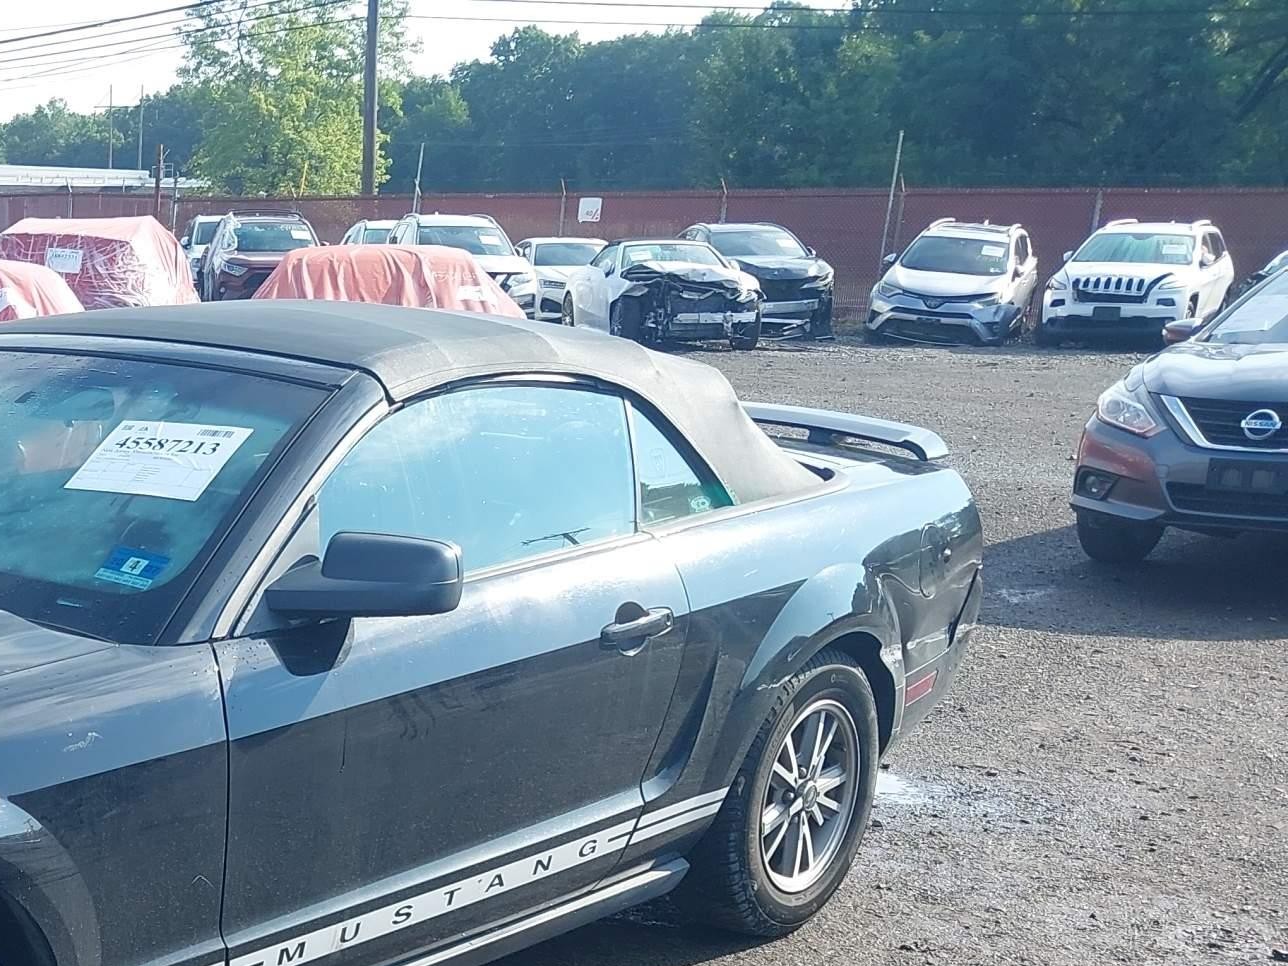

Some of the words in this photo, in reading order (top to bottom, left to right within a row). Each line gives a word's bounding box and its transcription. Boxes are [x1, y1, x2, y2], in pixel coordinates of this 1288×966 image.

[1244, 419, 1277, 428] NISSAN
[114, 435, 221, 456] 45587213
[128, 559, 141, 572] 4
[276, 838, 599, 966] MUSTANG
